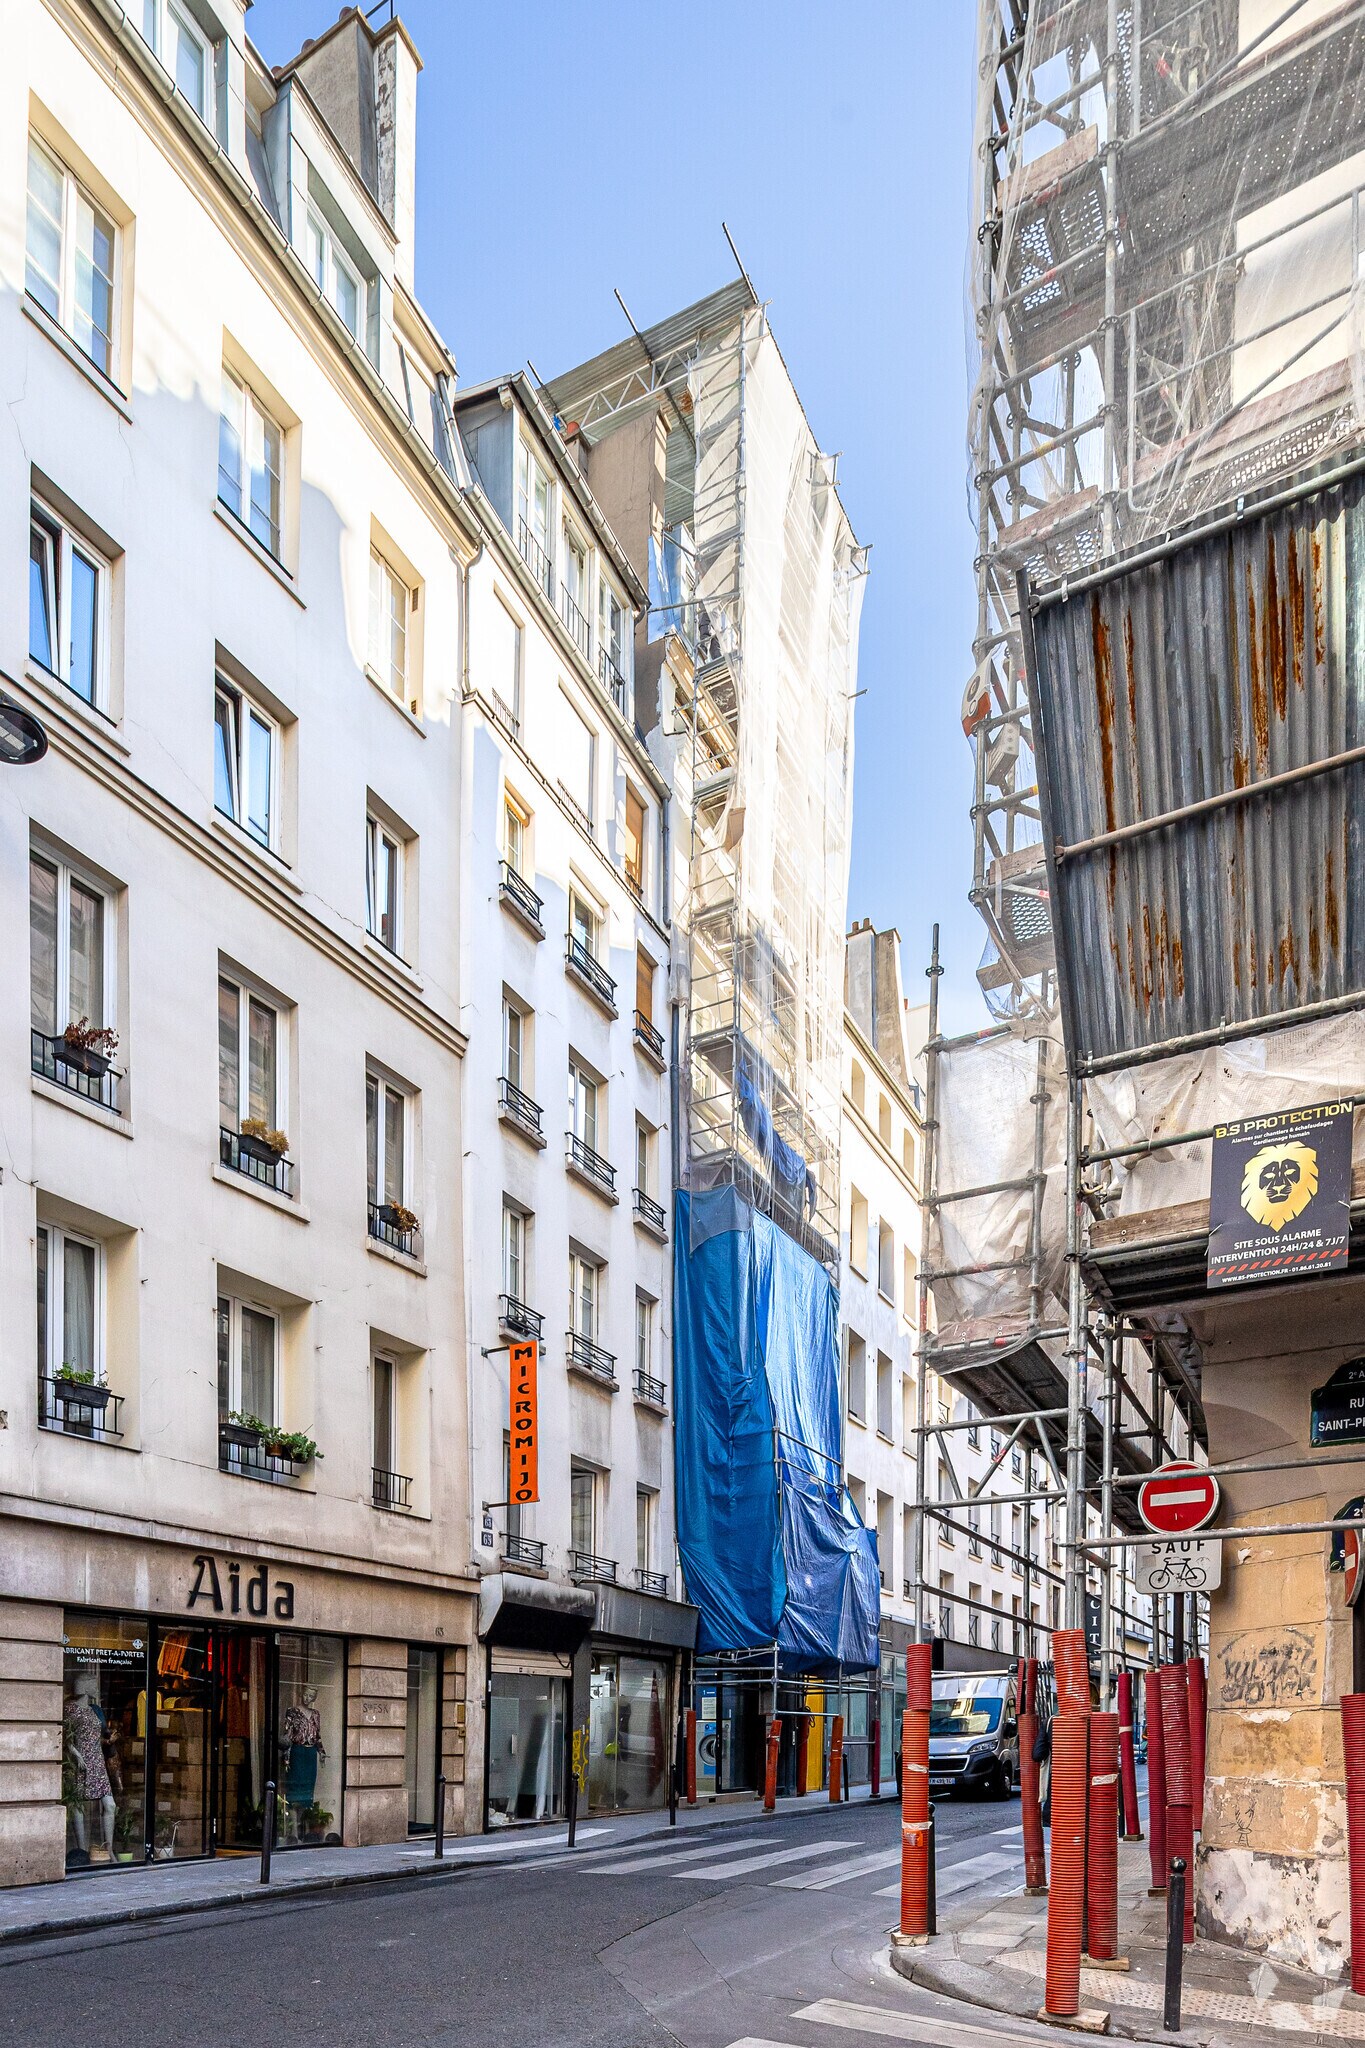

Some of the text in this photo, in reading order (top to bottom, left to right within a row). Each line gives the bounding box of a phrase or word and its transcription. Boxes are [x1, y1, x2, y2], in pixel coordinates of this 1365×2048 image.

[1215, 1101, 1353, 1139] B.S PROTECTION
[1231, 1136, 1254, 1144] Alarmes
[1263, 1129, 1289, 1138] chantiers
[1253, 1131, 1310, 1146] Gardiennage humain
[1211, 1235, 1346, 1265] INTERVENTION 24H/24 & 7J/7
[1233, 1228, 1322, 1250] SITE SOUS ALARME
[514, 1346, 533, 1501] MICROMIJO
[1151, 1540, 1205, 1555] SAUF
[186, 1554, 295, 1620] Aïda
[76, 1656, 108, 1664] Fabrication
